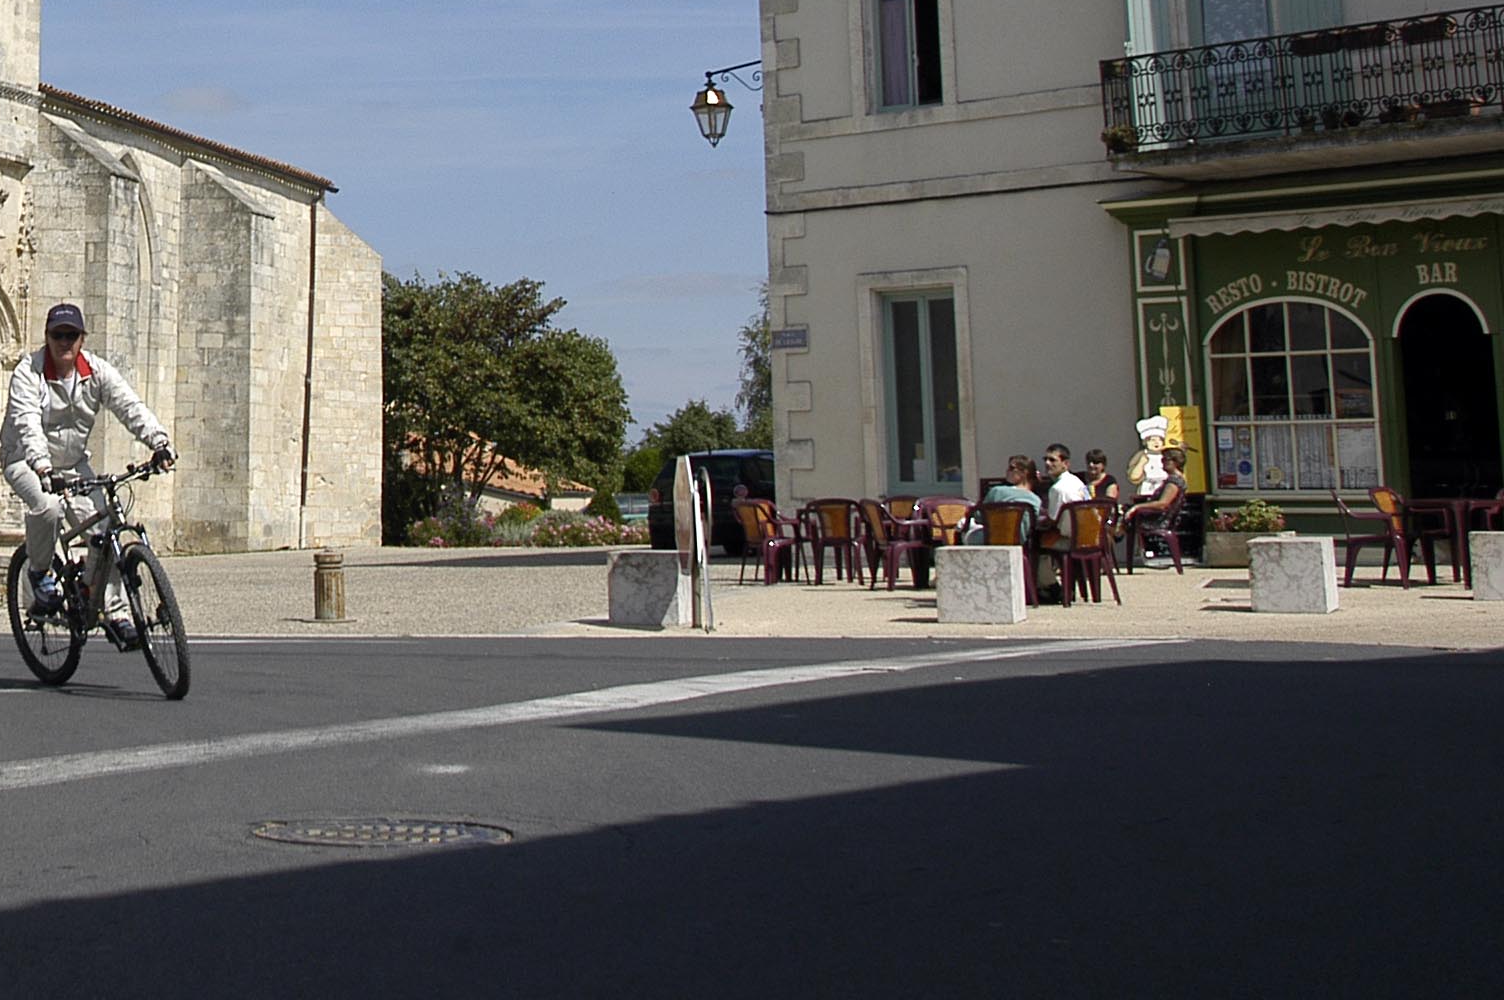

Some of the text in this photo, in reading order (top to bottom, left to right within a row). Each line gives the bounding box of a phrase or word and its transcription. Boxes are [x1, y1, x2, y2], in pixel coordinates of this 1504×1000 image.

[1297, 231, 1488, 263] Le Bon Vieux
[1415, 262, 1458, 284] BAR
[1204, 270, 1369, 314] RESTO BISTROT
